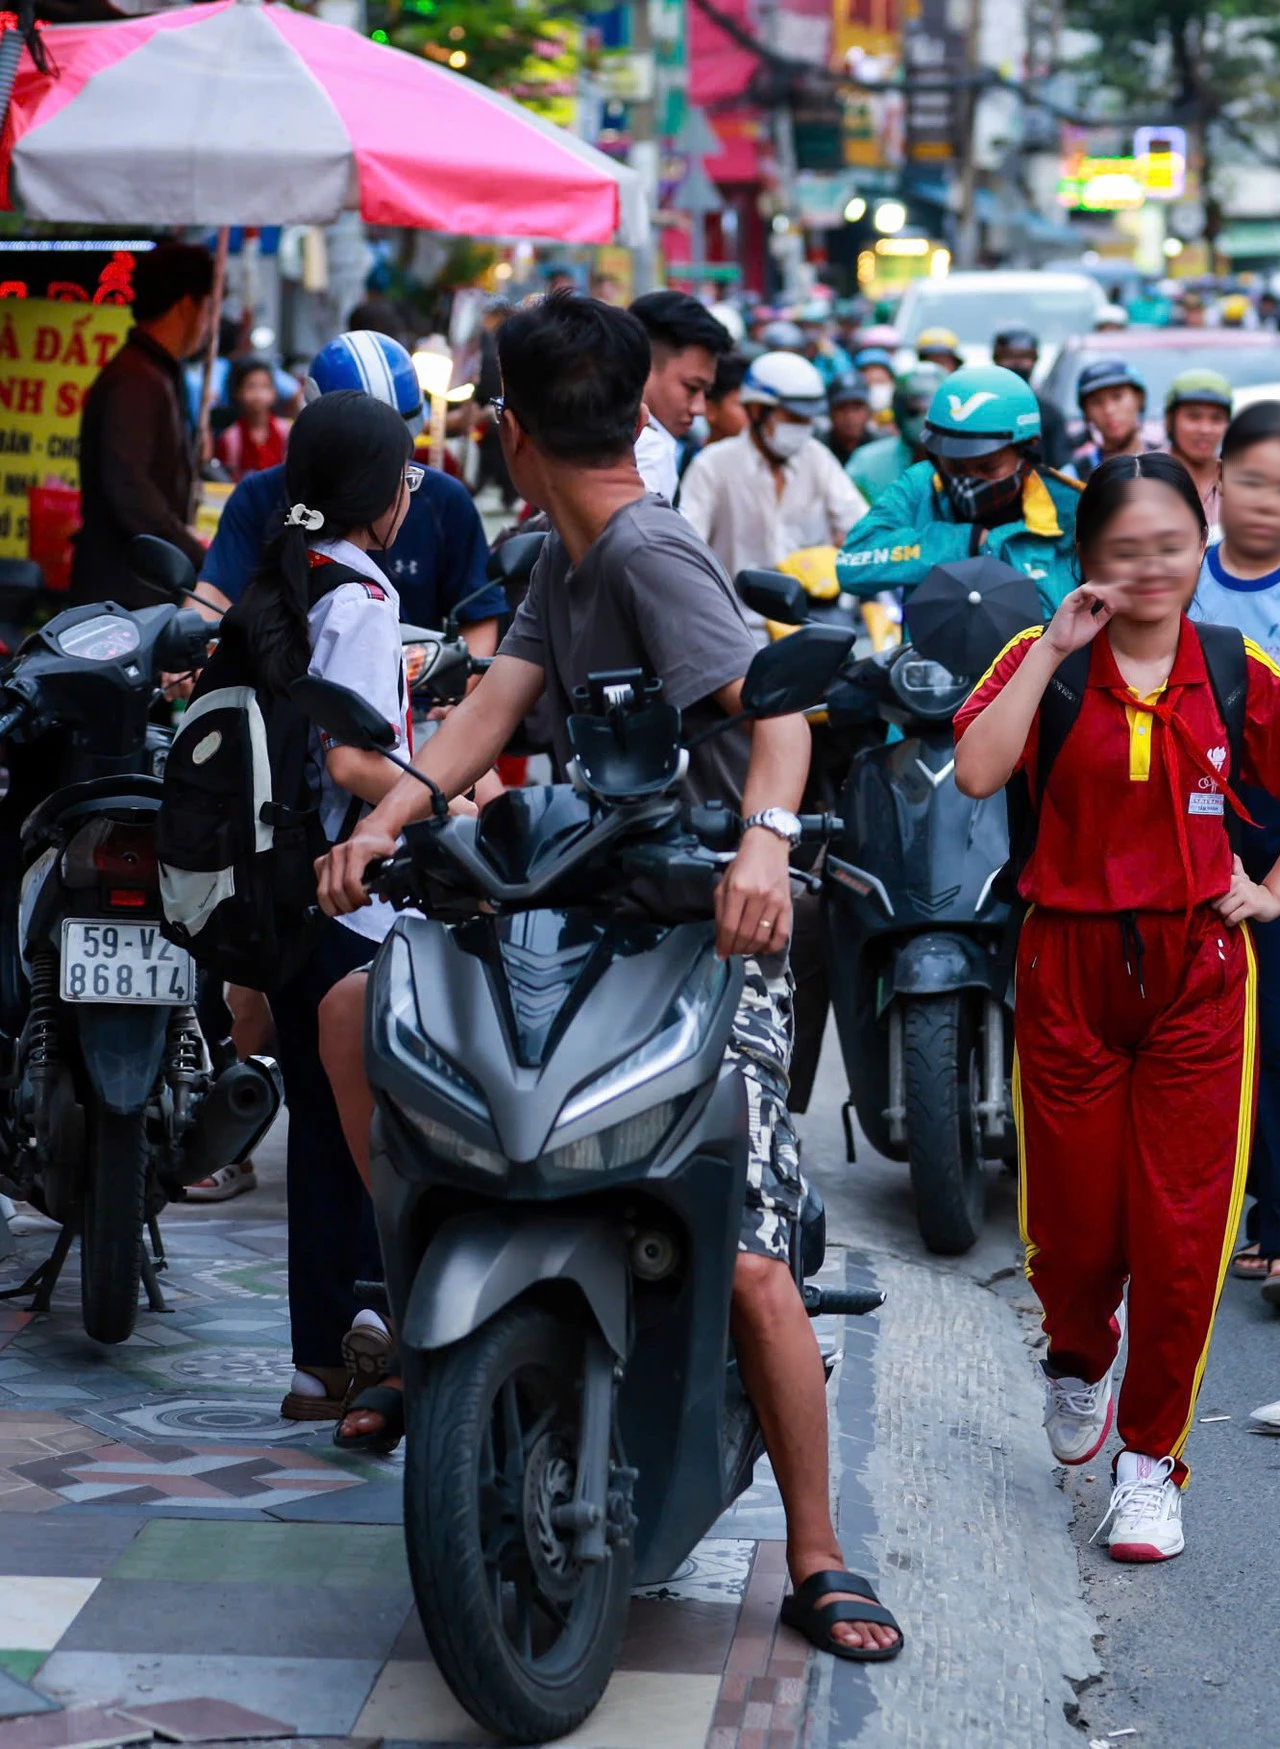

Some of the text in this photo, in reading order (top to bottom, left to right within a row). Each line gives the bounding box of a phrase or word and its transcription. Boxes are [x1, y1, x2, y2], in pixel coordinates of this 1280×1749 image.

[891, 545, 920, 562] SM
[83, 926, 174, 962] 59-V2
[70, 963, 185, 999] 868.14
